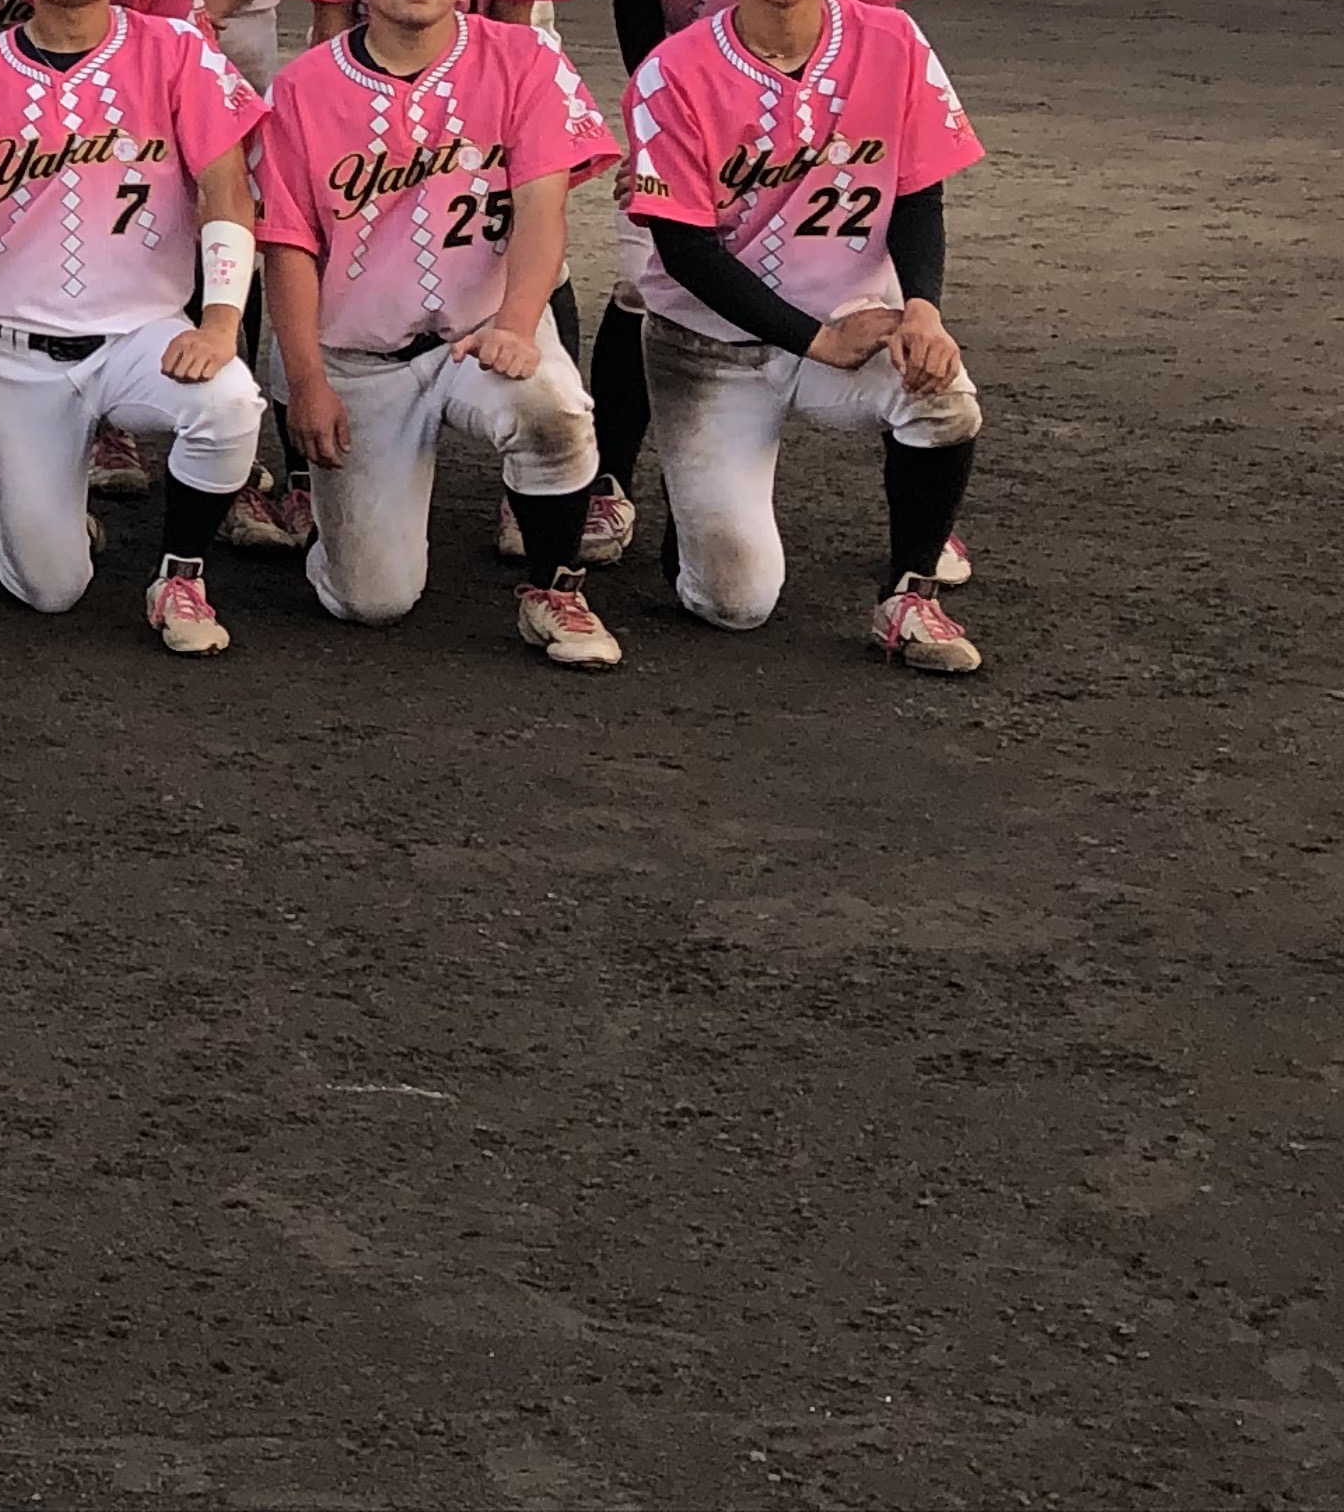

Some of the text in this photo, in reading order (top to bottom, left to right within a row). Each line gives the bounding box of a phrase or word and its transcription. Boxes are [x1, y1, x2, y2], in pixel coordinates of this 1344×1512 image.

[110, 184, 152, 235] 7
[443, 190, 512, 248] 25
[795, 187, 881, 238] 22
